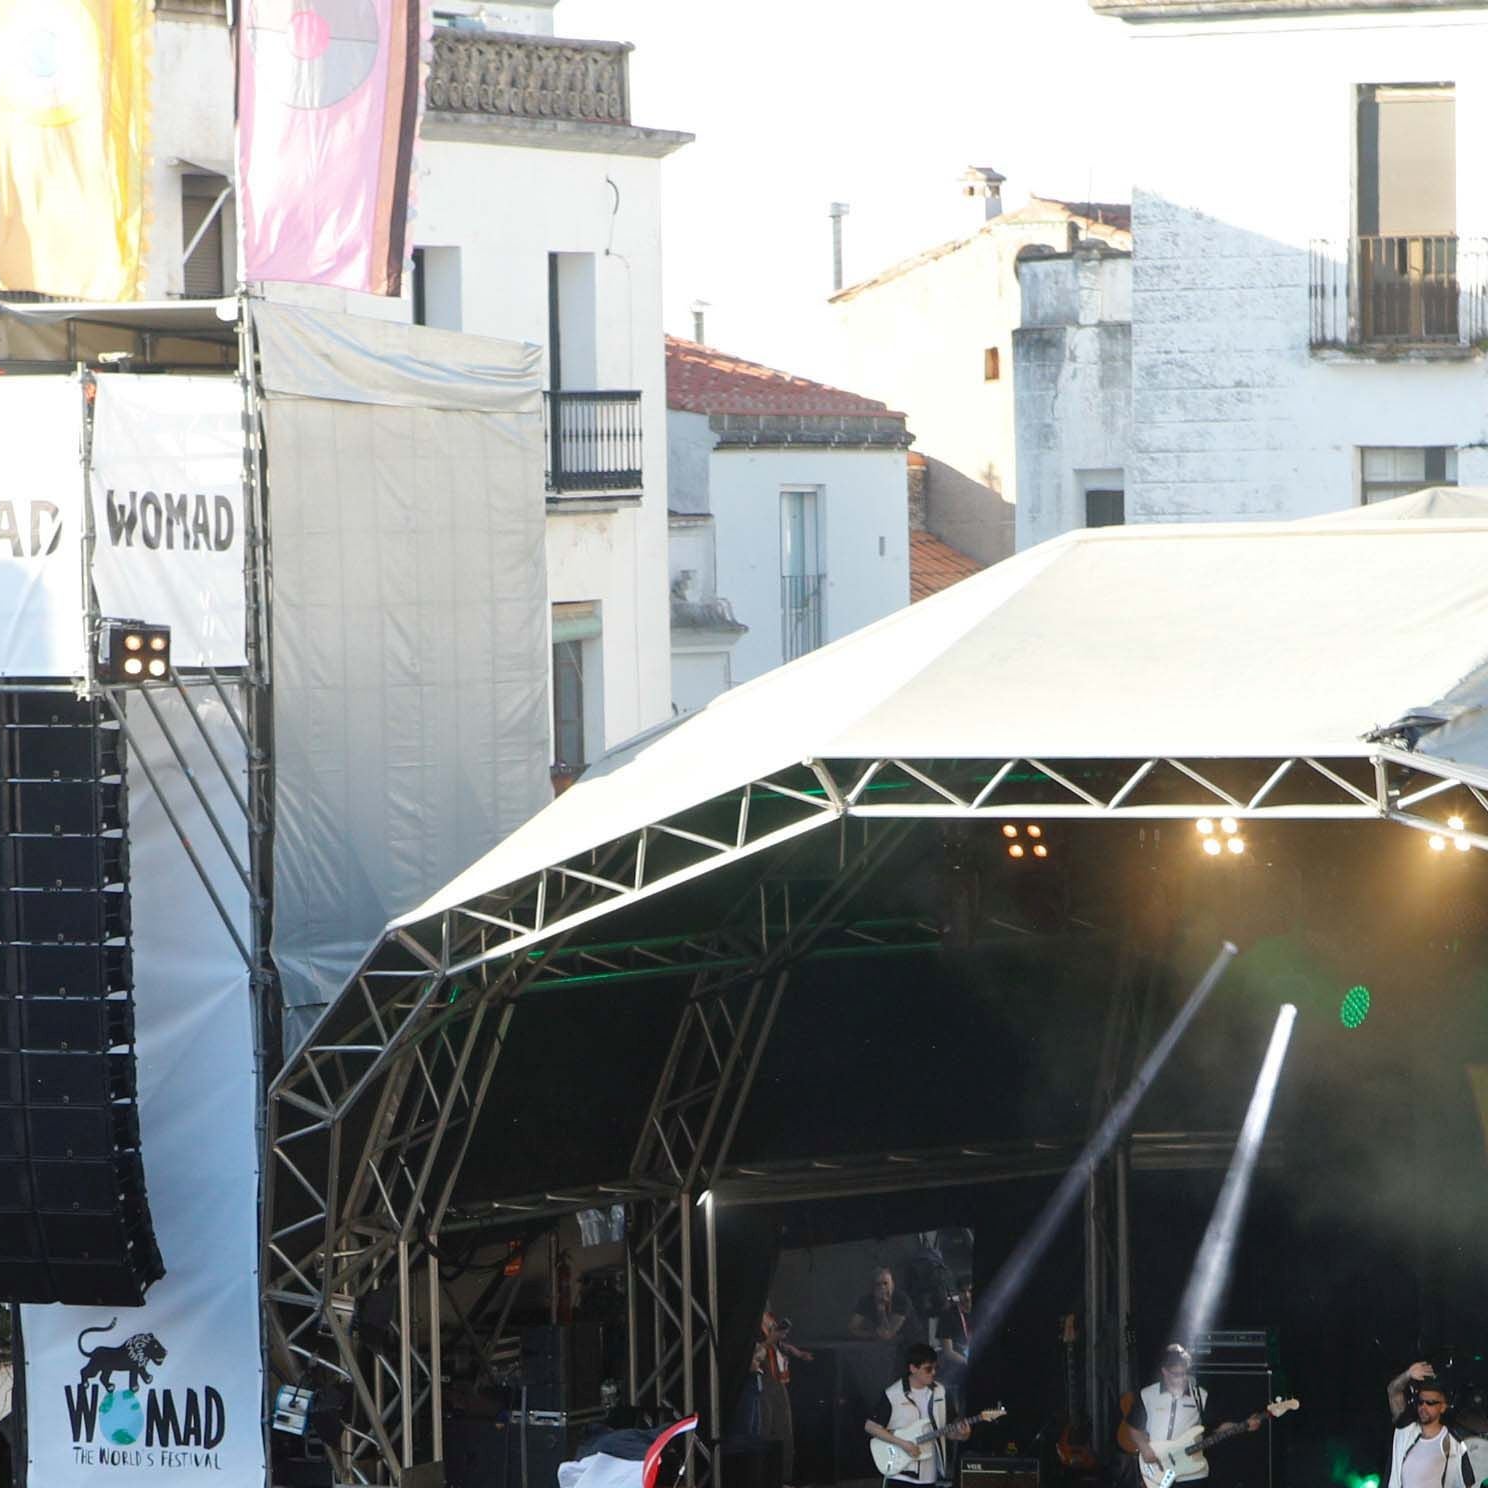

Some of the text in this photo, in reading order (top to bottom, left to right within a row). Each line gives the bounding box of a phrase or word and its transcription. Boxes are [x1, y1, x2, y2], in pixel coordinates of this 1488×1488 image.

[107, 489, 235, 552] WOMAD
[64, 1384, 225, 1450] WOMAD
[73, 1447, 94, 1465] THE
[161, 1451, 223, 1471] FESTIVAL
